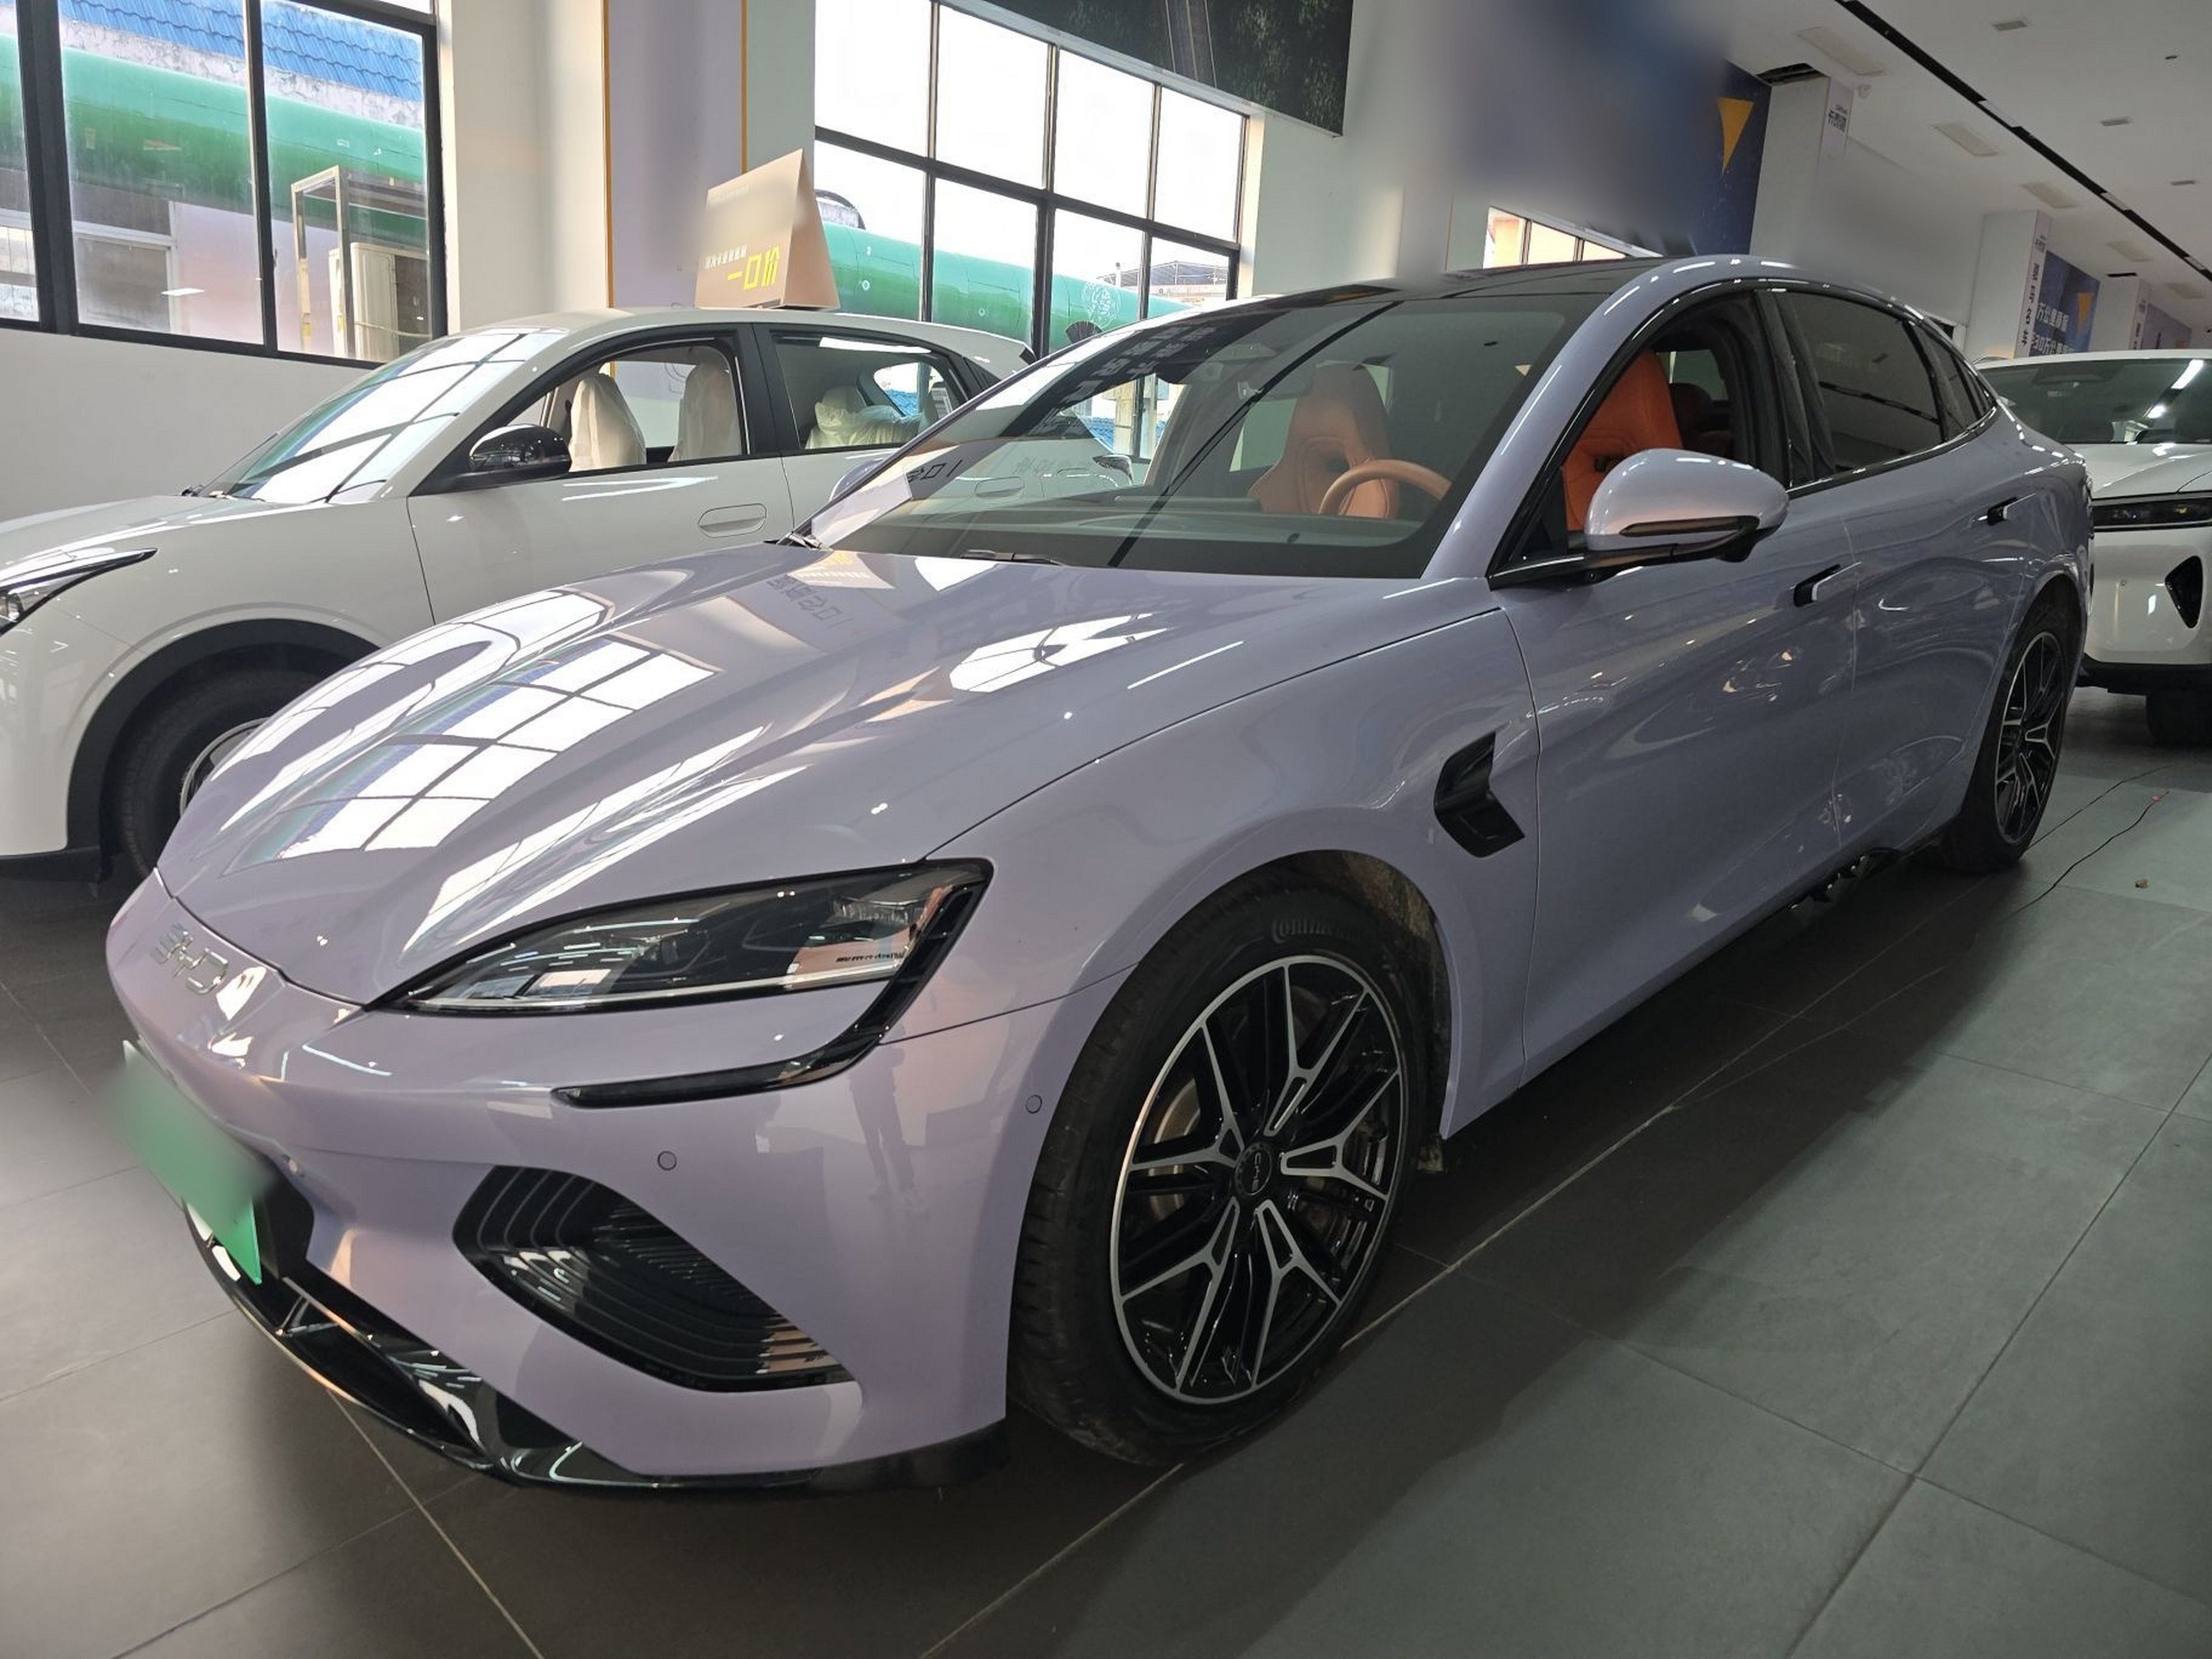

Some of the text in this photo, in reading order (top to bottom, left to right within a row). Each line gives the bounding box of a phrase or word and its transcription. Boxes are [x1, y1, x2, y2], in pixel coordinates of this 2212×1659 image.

[727, 245, 780, 291] 一口价
[150, 922, 228, 994] BYD
